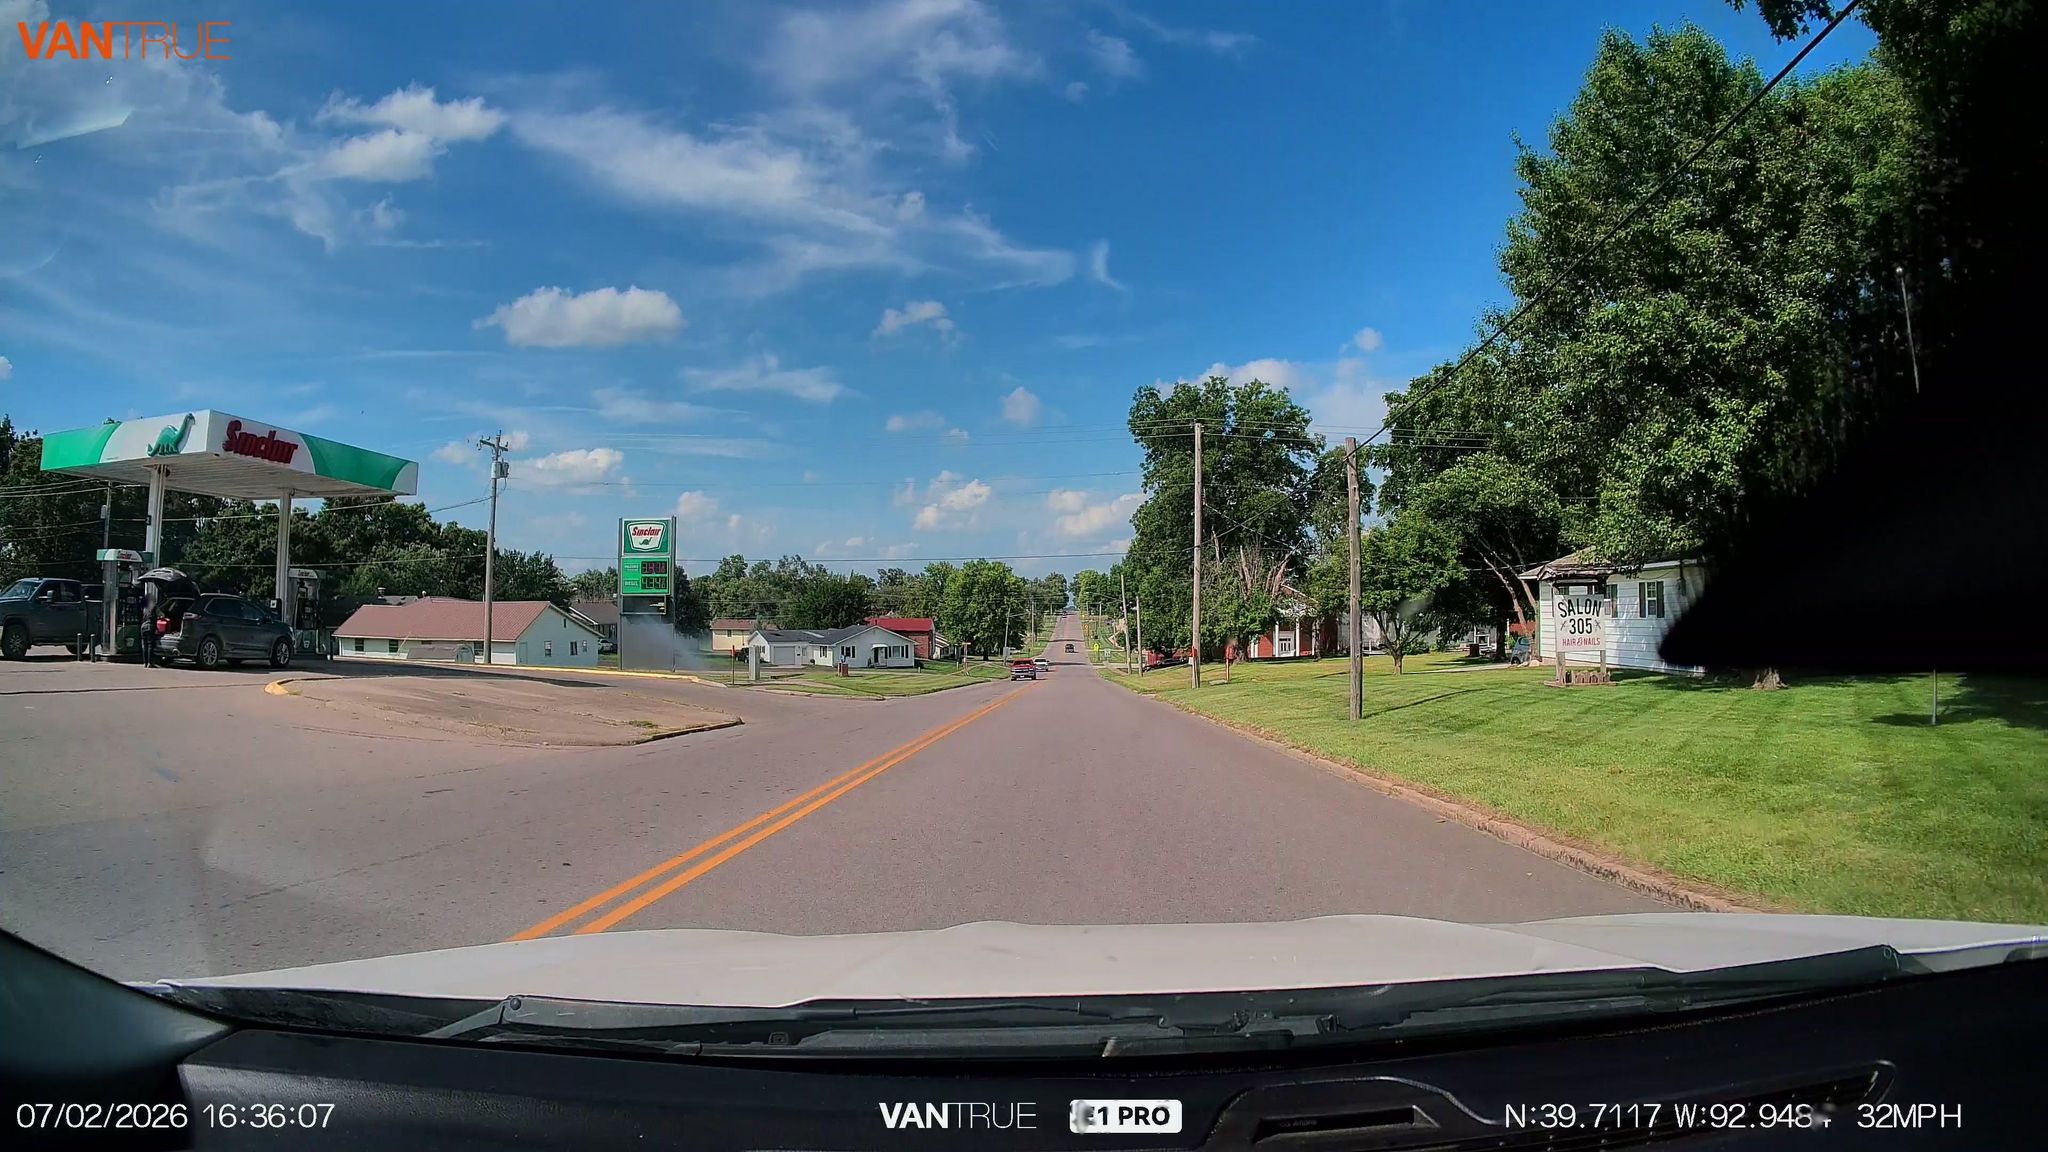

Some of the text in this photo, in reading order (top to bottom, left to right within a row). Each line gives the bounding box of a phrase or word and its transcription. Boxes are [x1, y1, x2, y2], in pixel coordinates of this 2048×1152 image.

[631, 526, 662, 537] Sinclair
[1557, 598, 1602, 618] SALON
[1569, 618, 1593, 635] 305
[1562, 638, 1576, 647] HAIR
[1583, 637, 1601, 646] NAILS
